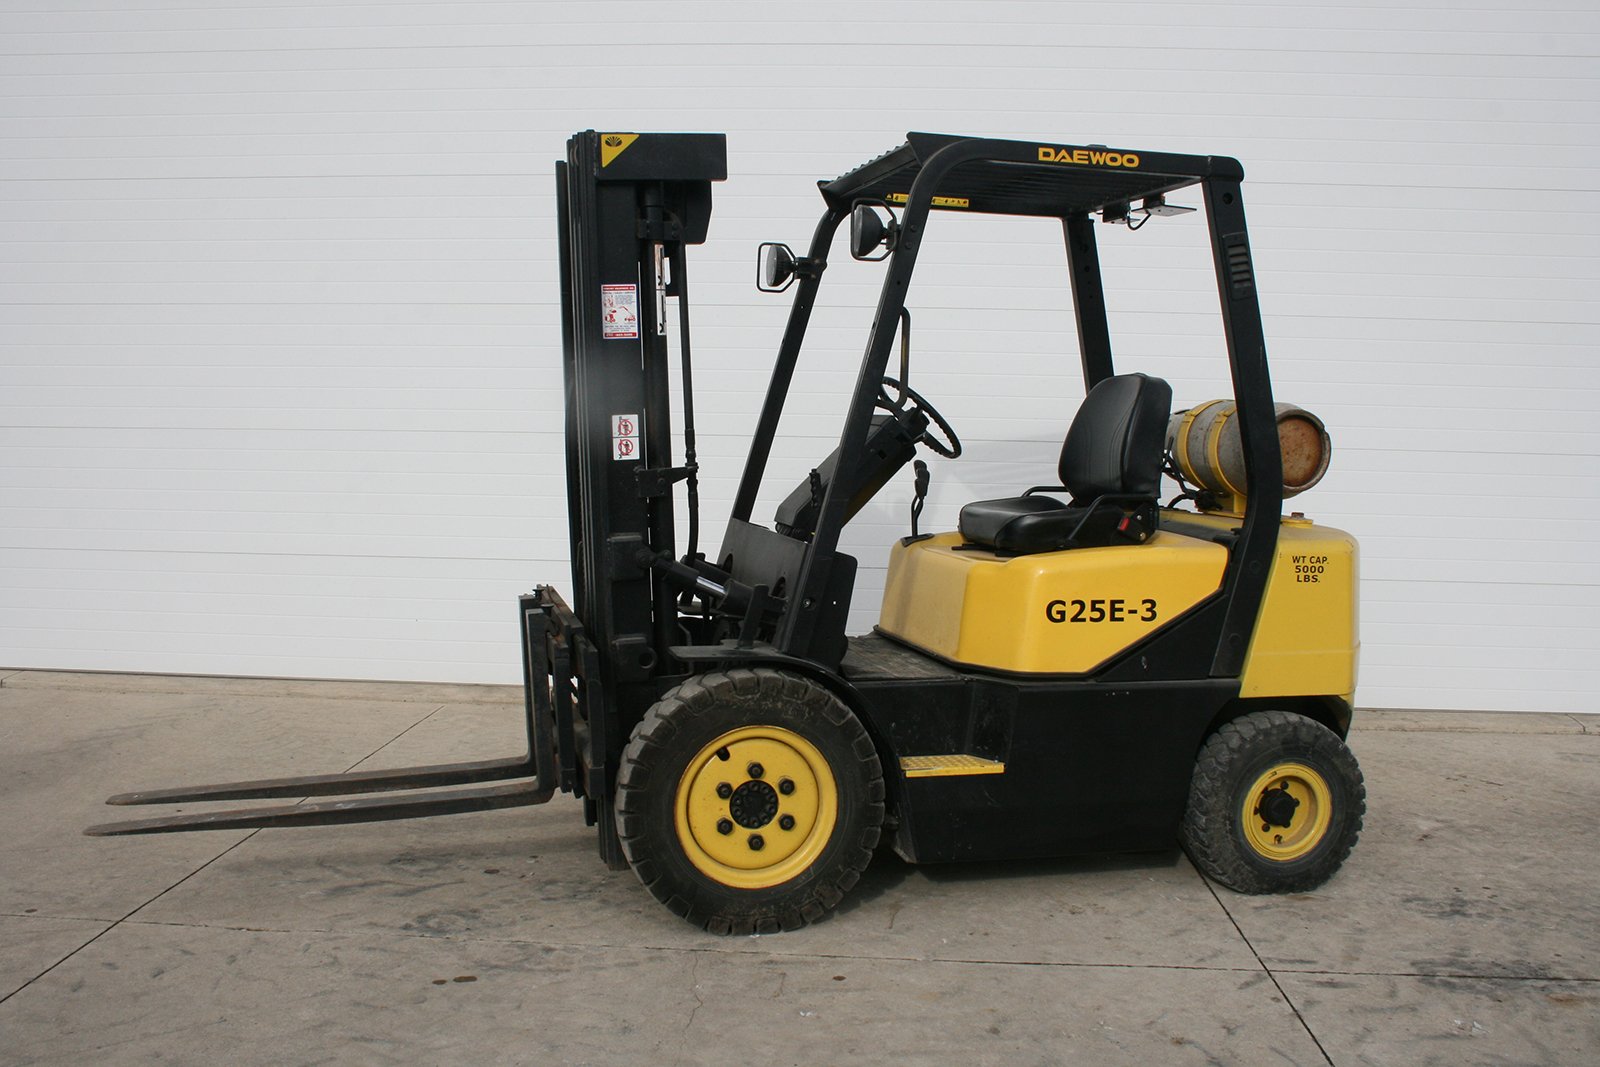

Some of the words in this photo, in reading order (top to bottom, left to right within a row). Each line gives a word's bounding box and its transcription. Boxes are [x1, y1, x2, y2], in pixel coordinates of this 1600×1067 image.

[1038, 147, 1140, 168] DAEWOO
[1292, 555, 1306, 564] WT
[1295, 565, 1324, 574] 5000
[1296, 574, 1320, 583] LBS.
[1045, 598, 1157, 623] G25E-3
